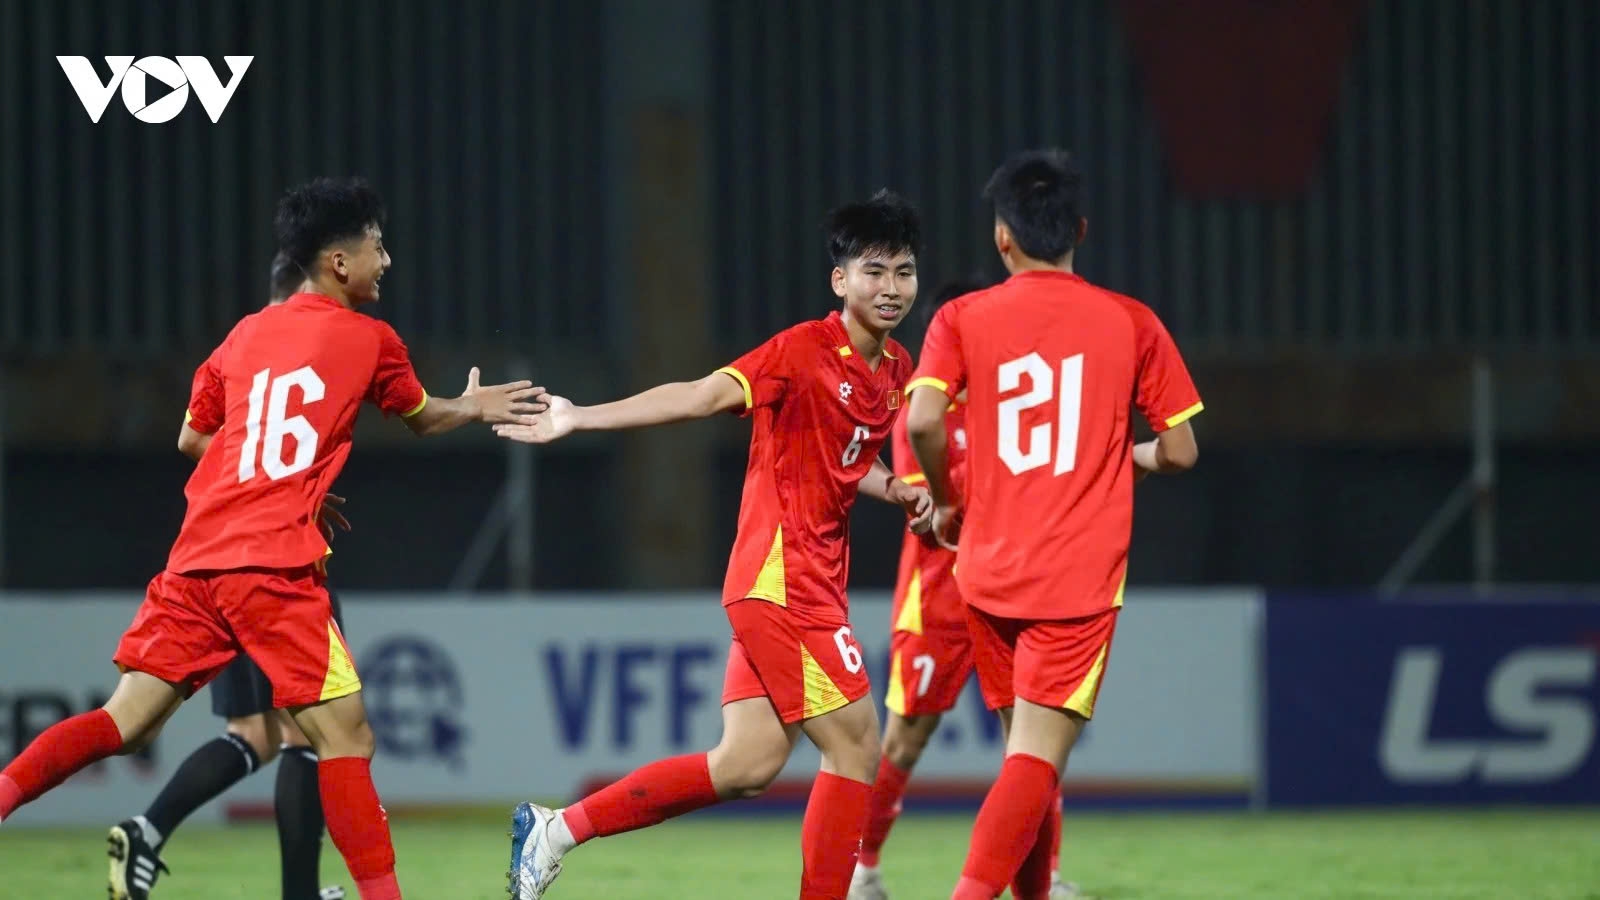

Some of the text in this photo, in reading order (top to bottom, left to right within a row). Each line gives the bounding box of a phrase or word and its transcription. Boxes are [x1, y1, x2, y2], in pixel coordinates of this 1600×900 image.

[238, 366, 325, 484] 16
[841, 426, 870, 467] 6
[998, 352, 1084, 477] 21
[833, 626, 862, 674] 6
[913, 654, 935, 696] 7
[1380, 648, 1596, 780] LS
